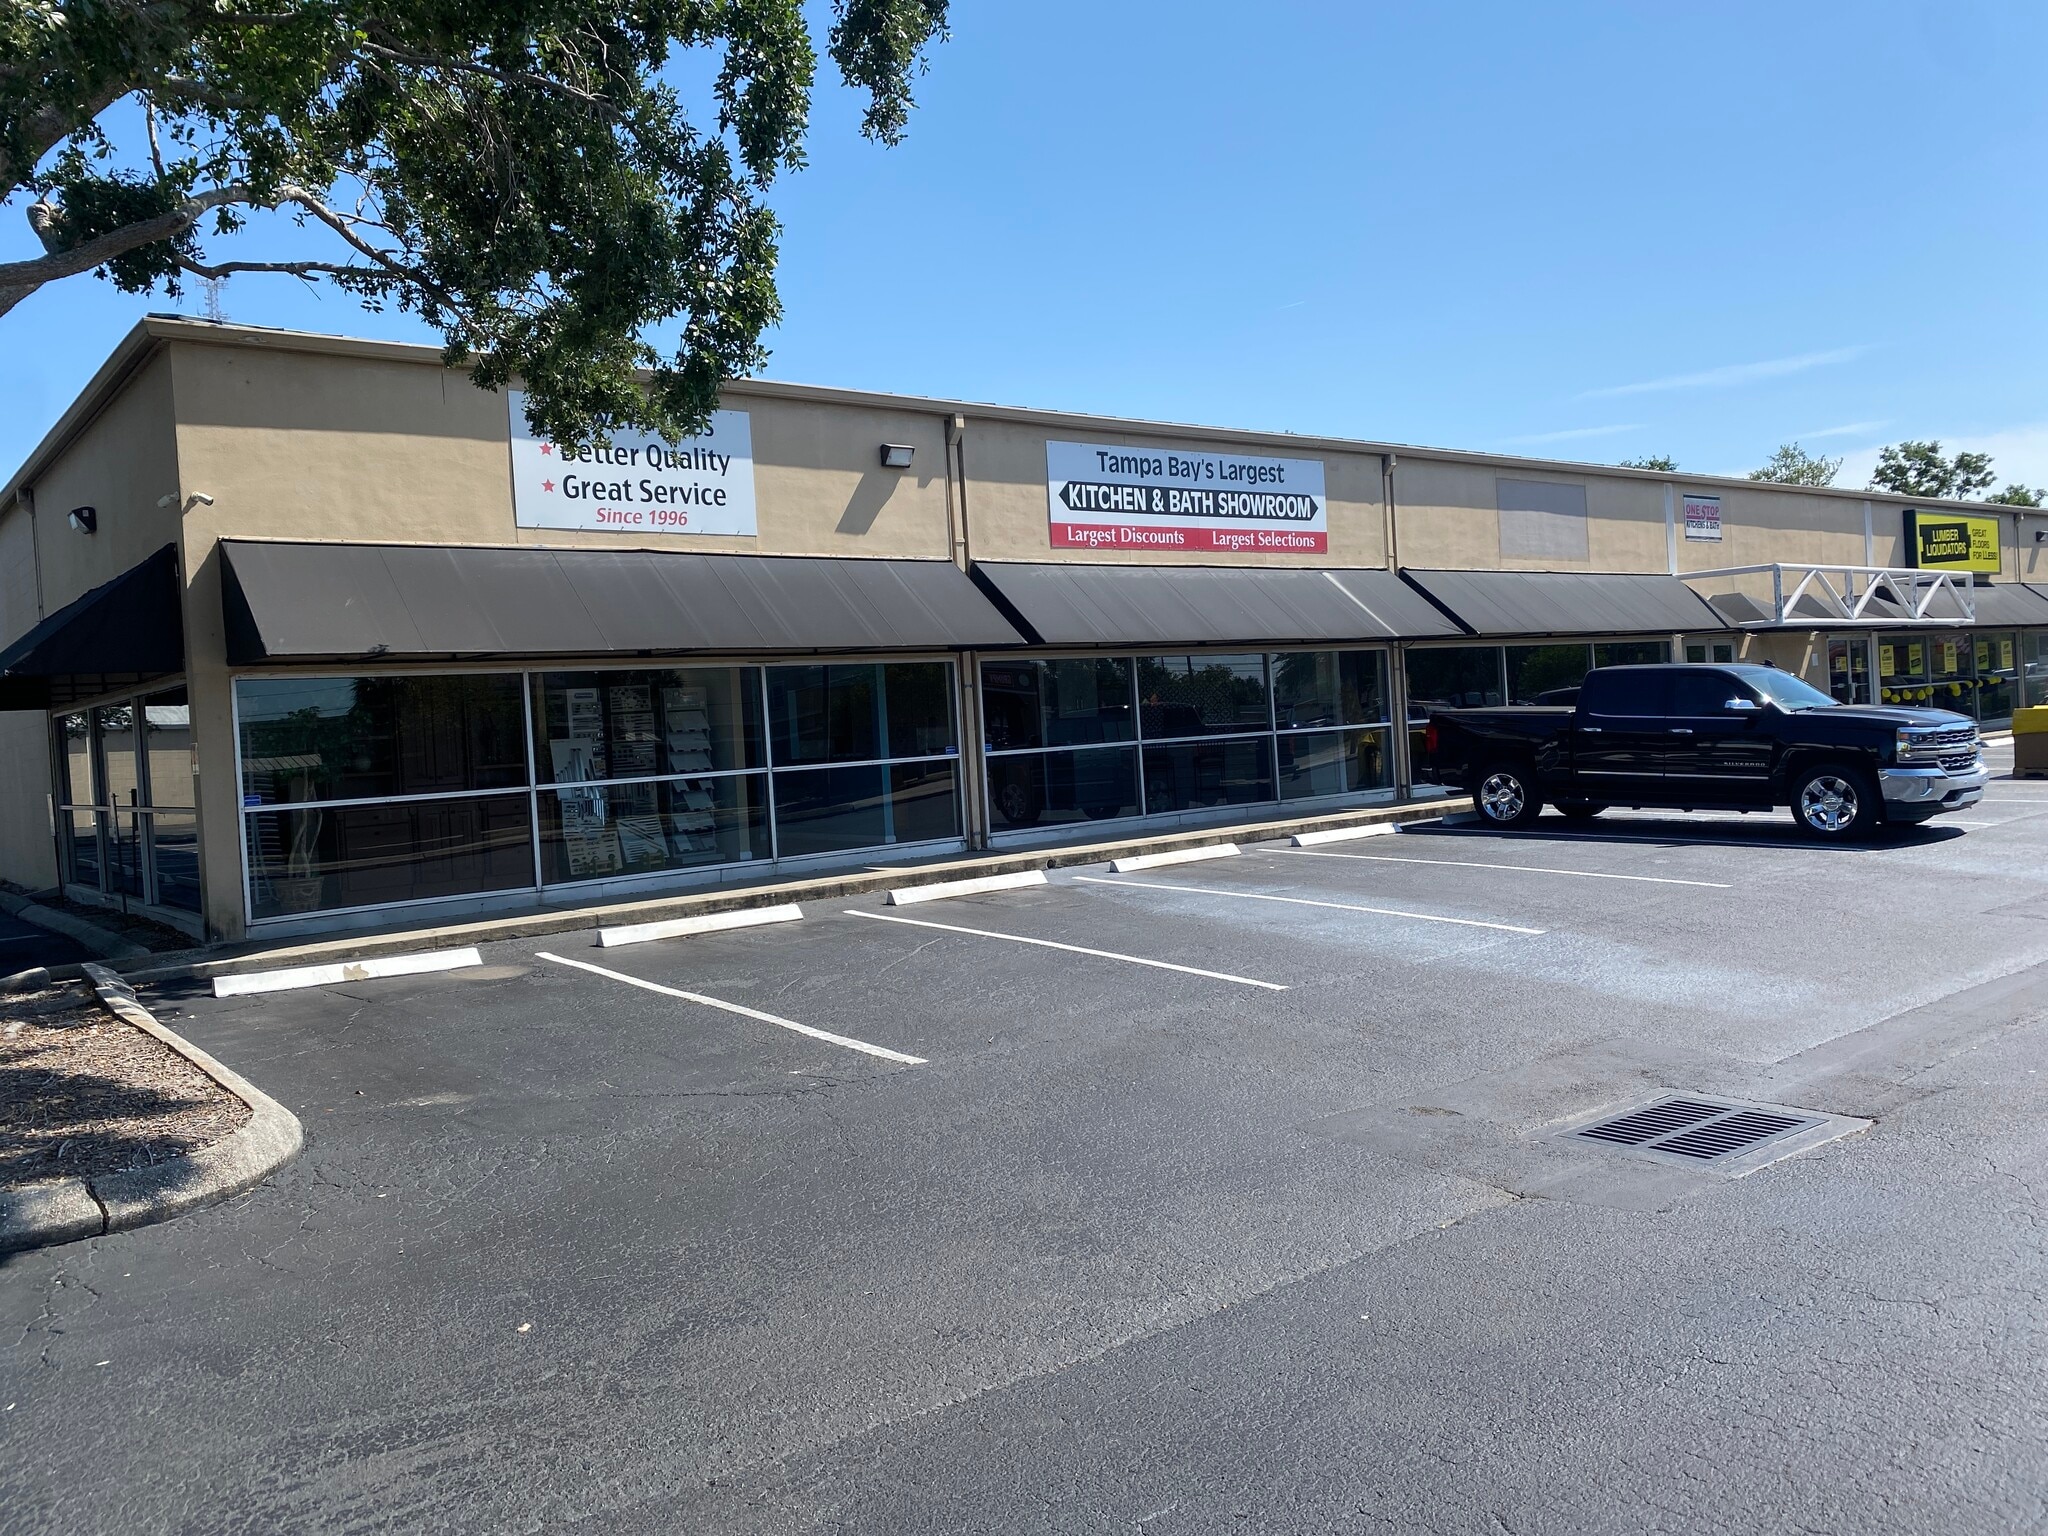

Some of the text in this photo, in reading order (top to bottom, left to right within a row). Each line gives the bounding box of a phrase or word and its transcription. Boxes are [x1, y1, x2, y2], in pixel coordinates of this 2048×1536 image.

[646, 444, 731, 477] Quality
[1096, 451, 1285, 485] Tampa Bay's Largest
[562, 474, 727, 507] Great Service
[1068, 484, 1311, 518] KITCHEN & BATH SHOWROOM
[596, 507, 688, 526] Since 1996
[1686, 504, 1719, 519] ONE STOP
[1067, 526, 1185, 546] Largest Discounts
[1212, 531, 1315, 550] Largest Selections
[1932, 529, 1959, 542] LUMBER
[1972, 528, 1987, 537] GREAT
[1926, 542, 1967, 557] LIQUIDATORS
